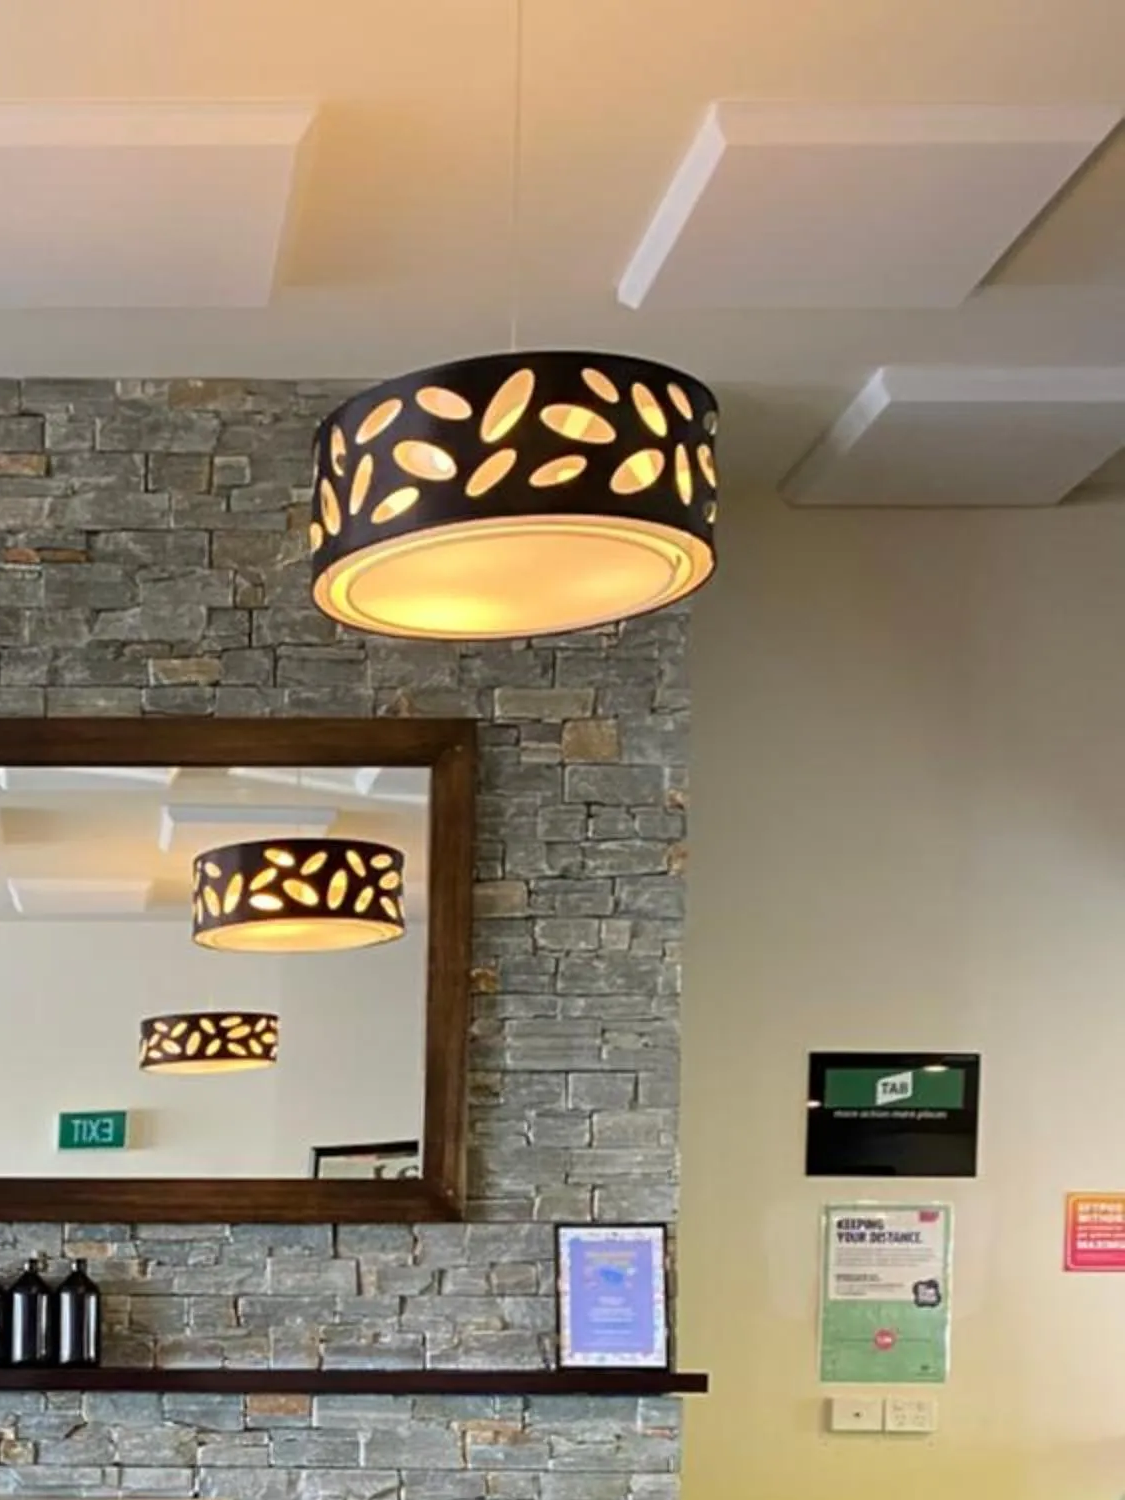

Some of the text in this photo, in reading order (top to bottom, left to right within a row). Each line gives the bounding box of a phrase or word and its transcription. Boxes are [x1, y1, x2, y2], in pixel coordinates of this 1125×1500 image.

[881, 1081, 909, 1095] TAB
[837, 1218, 885, 1230] KEEPING
[837, 1231, 867, 1243] YOUR
